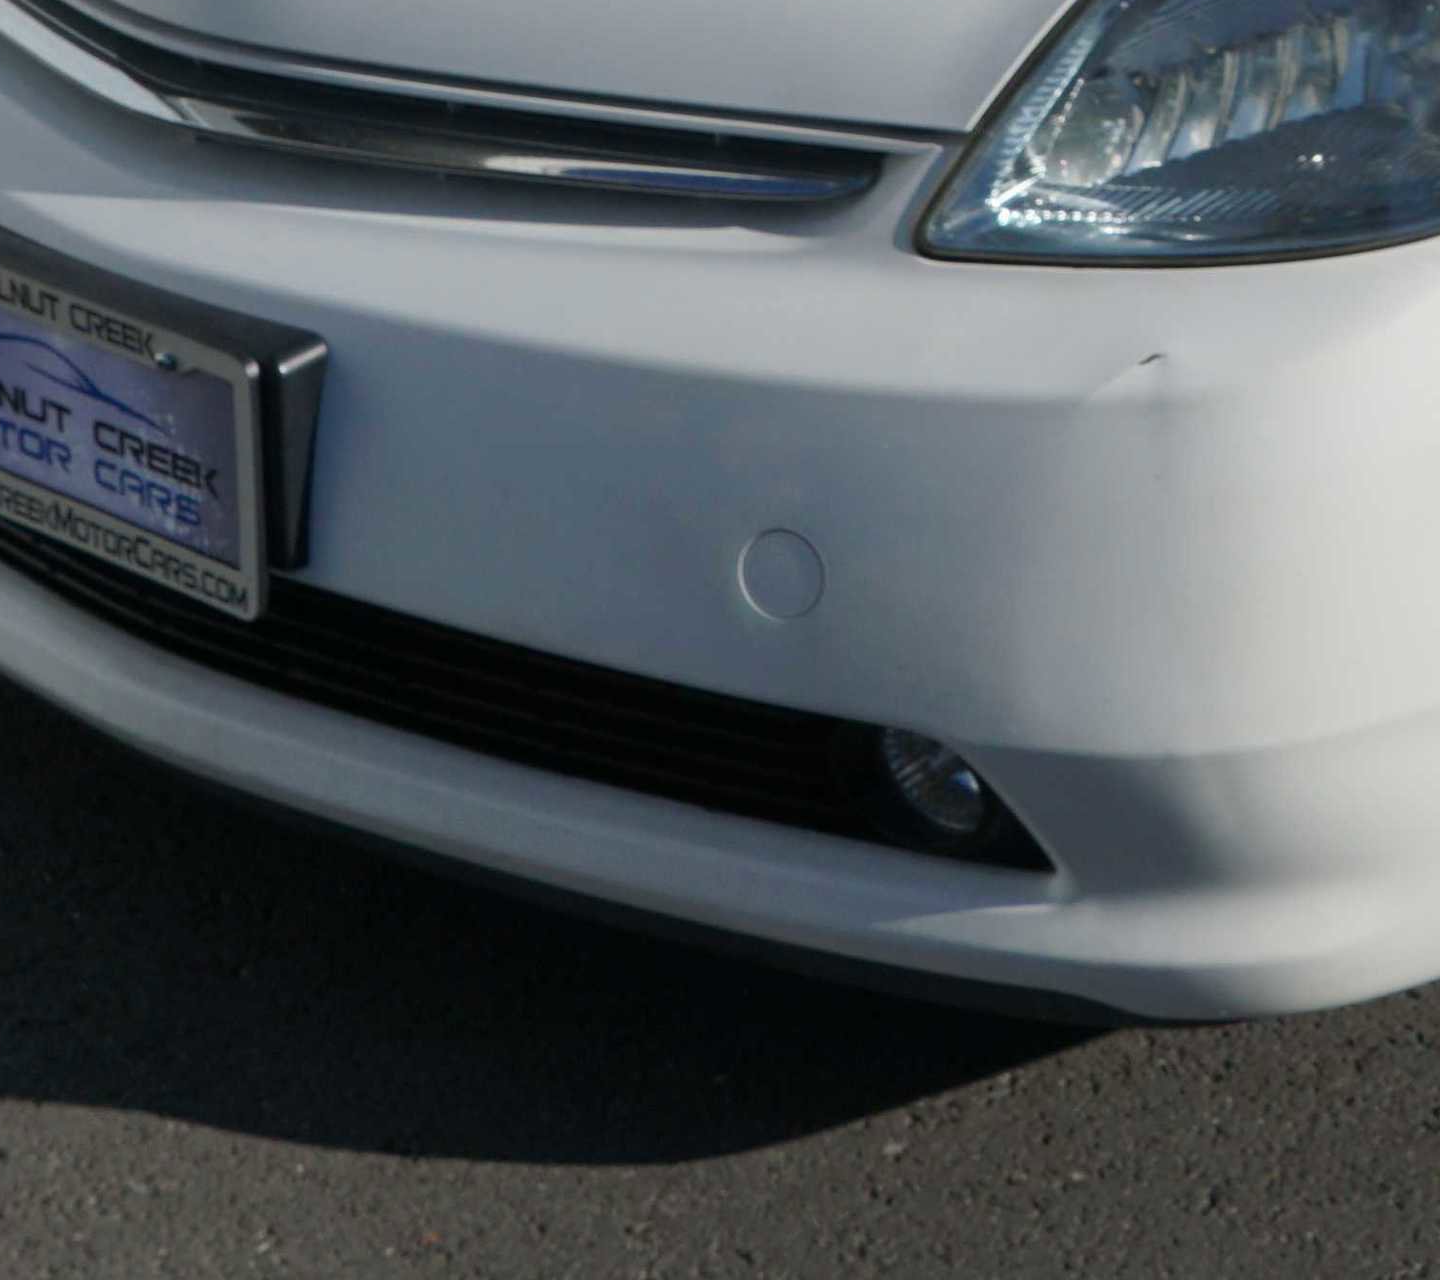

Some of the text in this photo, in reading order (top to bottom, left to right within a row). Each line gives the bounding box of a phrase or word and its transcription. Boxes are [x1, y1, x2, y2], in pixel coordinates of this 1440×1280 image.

[68, 303, 157, 360] CREEK
[93, 419, 222, 500] CREEK
[93, 457, 203, 526] CARS
